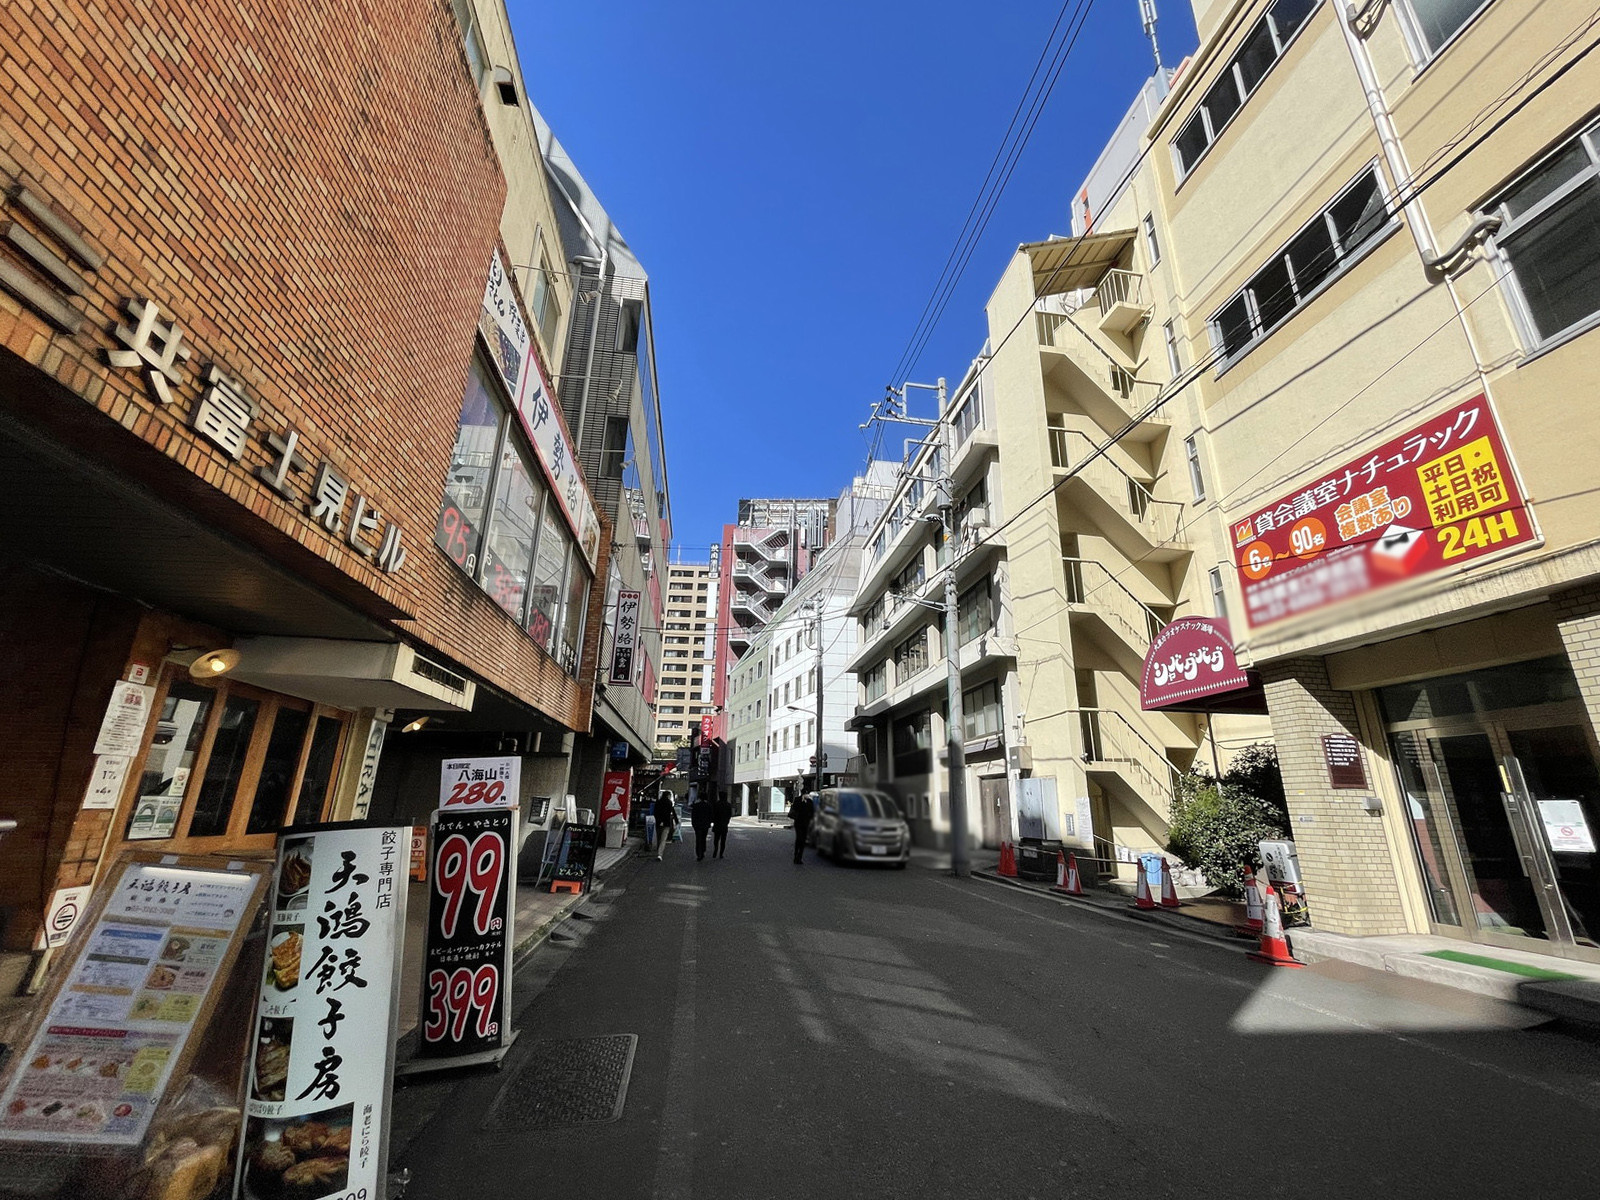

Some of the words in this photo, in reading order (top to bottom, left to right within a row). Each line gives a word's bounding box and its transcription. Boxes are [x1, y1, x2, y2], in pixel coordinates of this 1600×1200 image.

[1254, 406, 1480, 538] 貸会議室ナチュラック
[1434, 485, 1501, 524] 利用可
[1437, 510, 1520, 561] 24H
[617, 600, 637, 645] 伊勢路
[457, 767, 498, 782] 八海山
[438, 817, 509, 832] おでん・やきとり
[375, 830, 398, 910] 餃子専門店
[294, 850, 371, 1102] 天鴻餃子房
